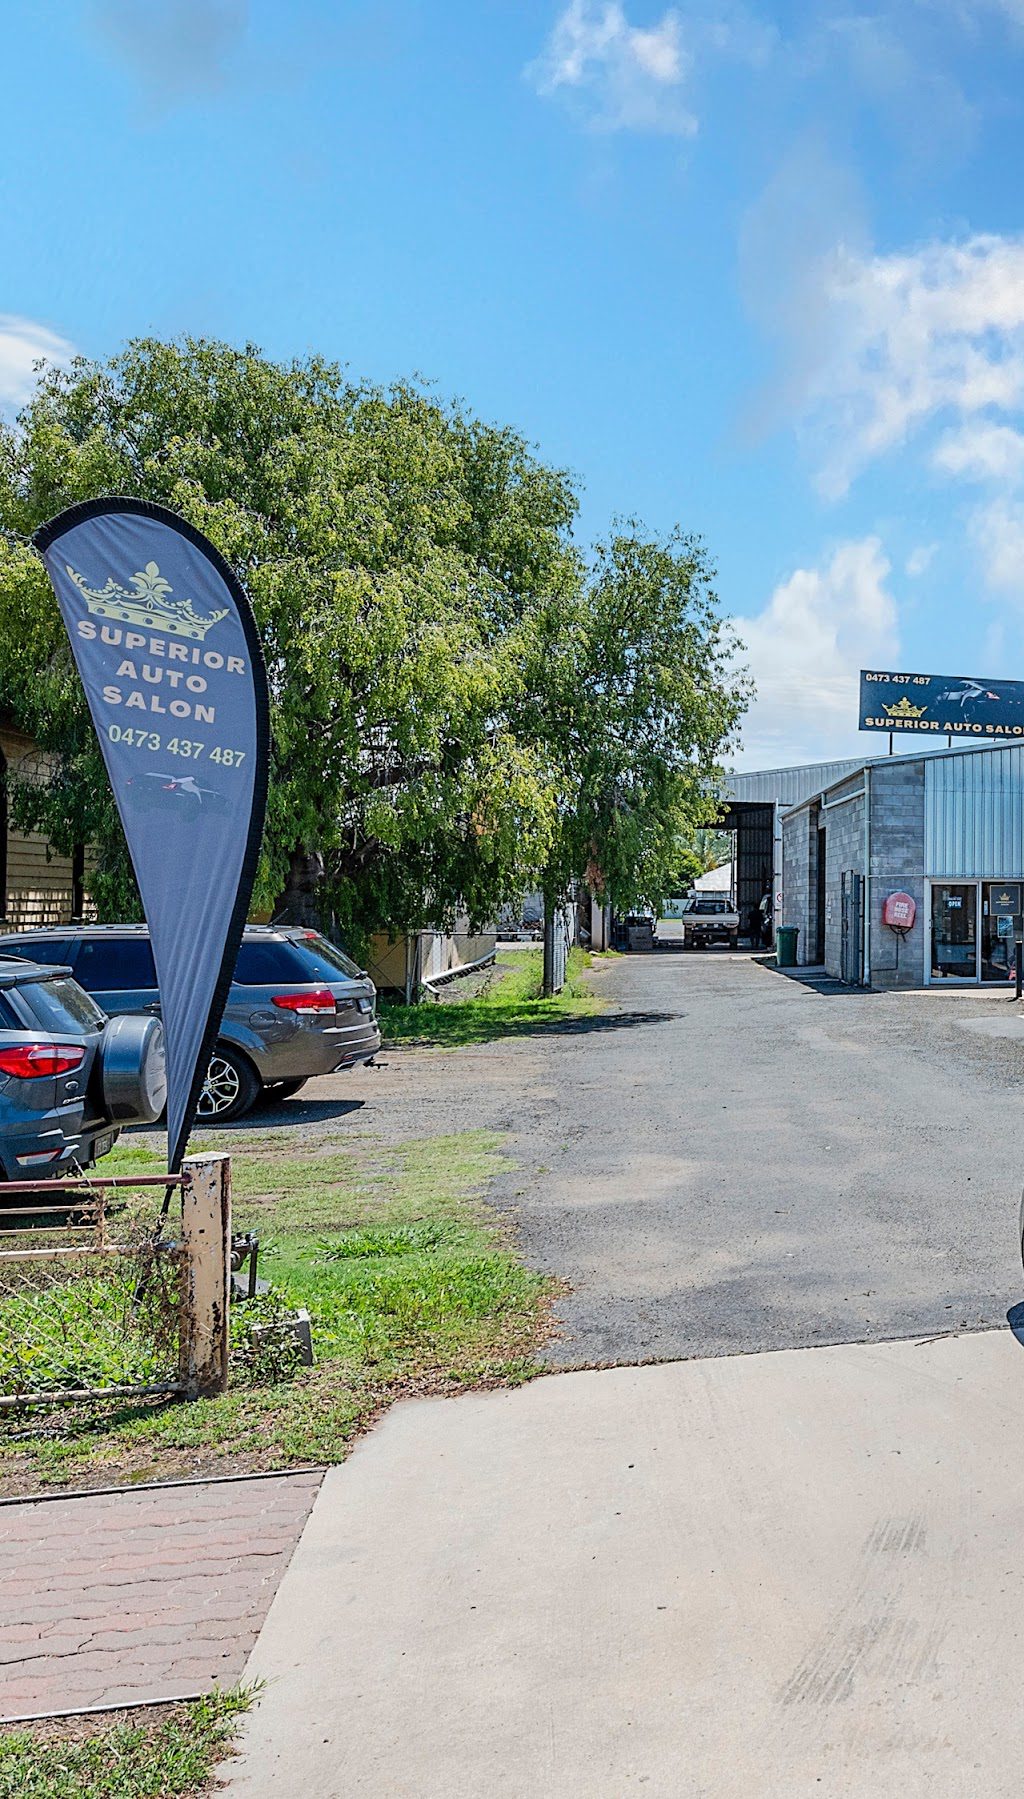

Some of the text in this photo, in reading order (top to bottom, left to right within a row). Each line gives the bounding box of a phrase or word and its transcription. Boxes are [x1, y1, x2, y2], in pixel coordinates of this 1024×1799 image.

[77, 620, 246, 675] SUPERIOR
[116, 660, 208, 693] AUTO
[865, 673, 931, 686] 0473 437 487
[102, 685, 216, 724] SALON
[864, 717, 940, 731] SUPERIOR
[943, 721, 982, 733] AUTO
[108, 725, 246, 768] 0473 437 487
